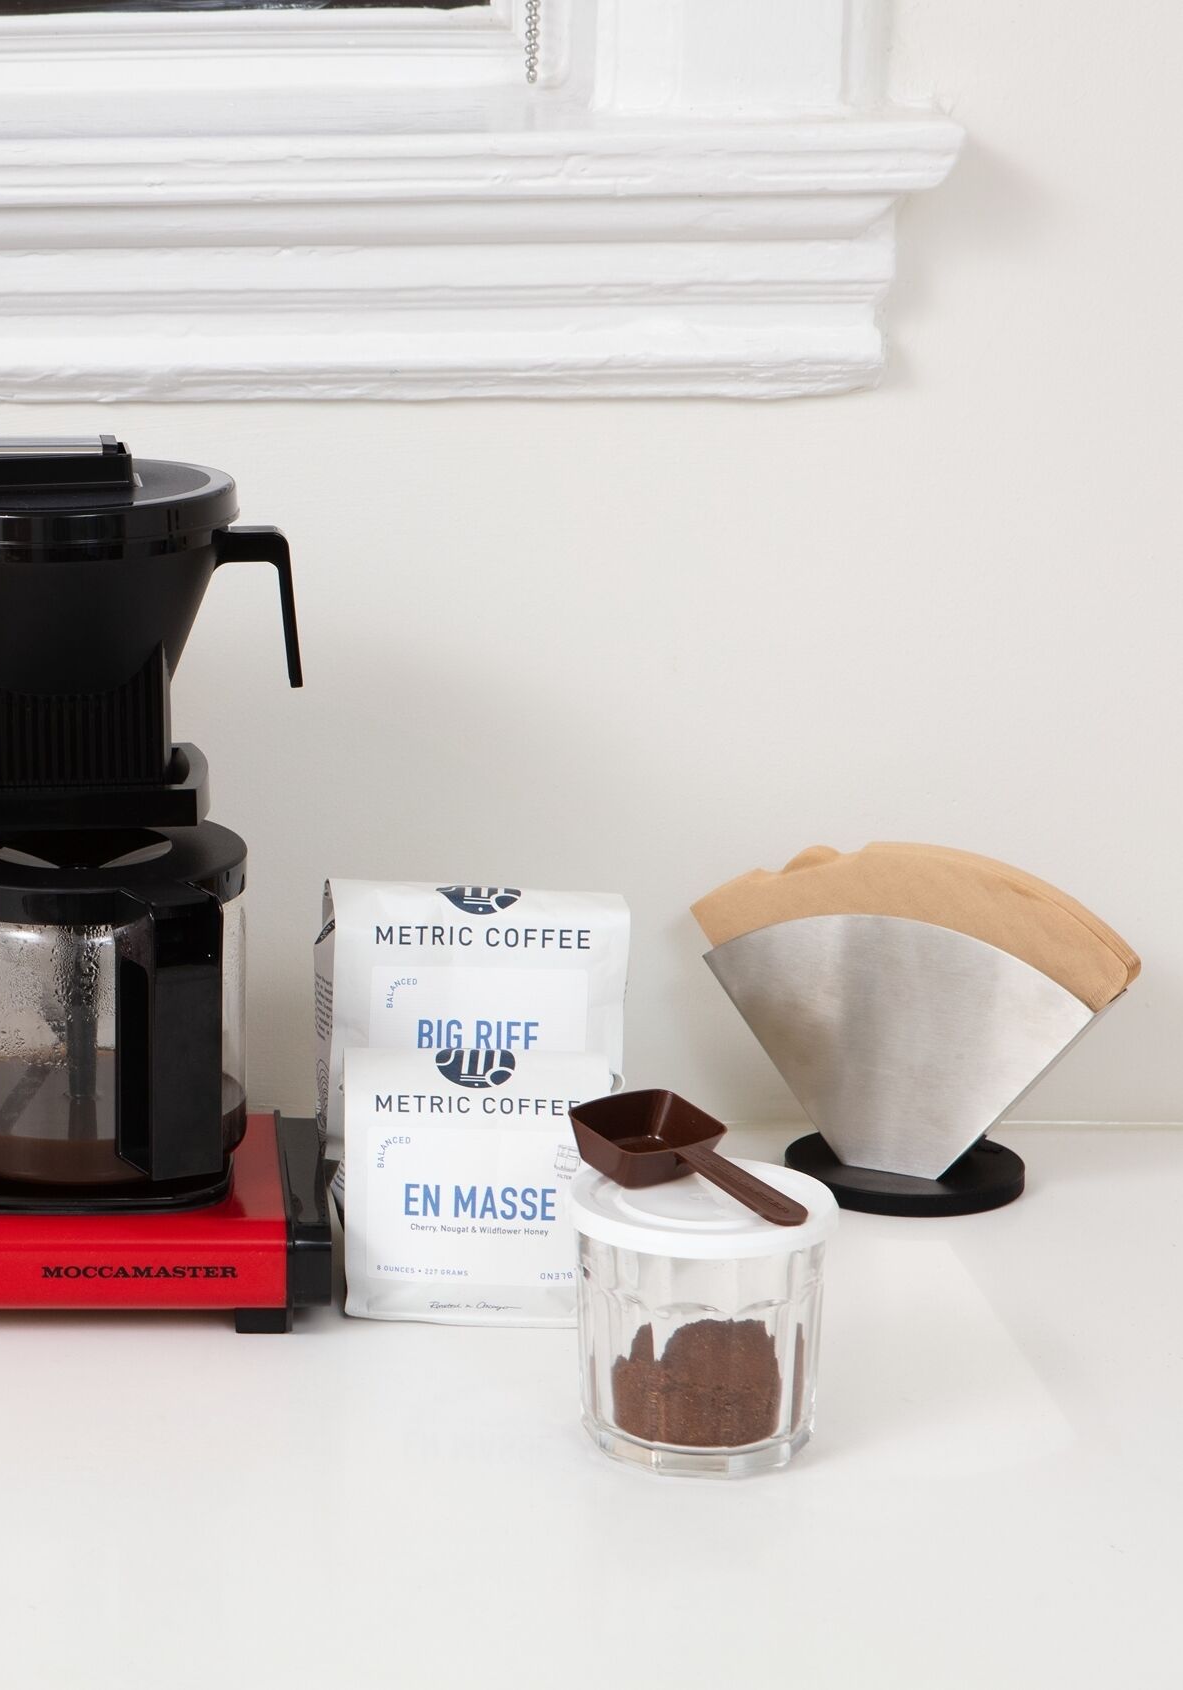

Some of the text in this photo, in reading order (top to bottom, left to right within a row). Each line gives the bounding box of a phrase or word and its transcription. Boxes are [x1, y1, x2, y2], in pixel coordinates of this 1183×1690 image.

[375, 926, 591, 950] METRIC COFFEE
[386, 978, 418, 1009] BALANCED
[417, 1019, 540, 1050] BIG RIFF
[375, 1095, 471, 1114] METRIC
[377, 1136, 411, 1168] BALANCED
[404, 1183, 557, 1221] EN MASSE
[440, 1225, 469, 1234] Nougat
[479, 1226, 521, 1235] Wildflower
[524, 1228, 549, 1237] Honey
[41, 1266, 238, 1278] MOCCAMASTER
[383, 1265, 415, 1274] OUNCES
[540, 1271, 573, 1280] BLEND
